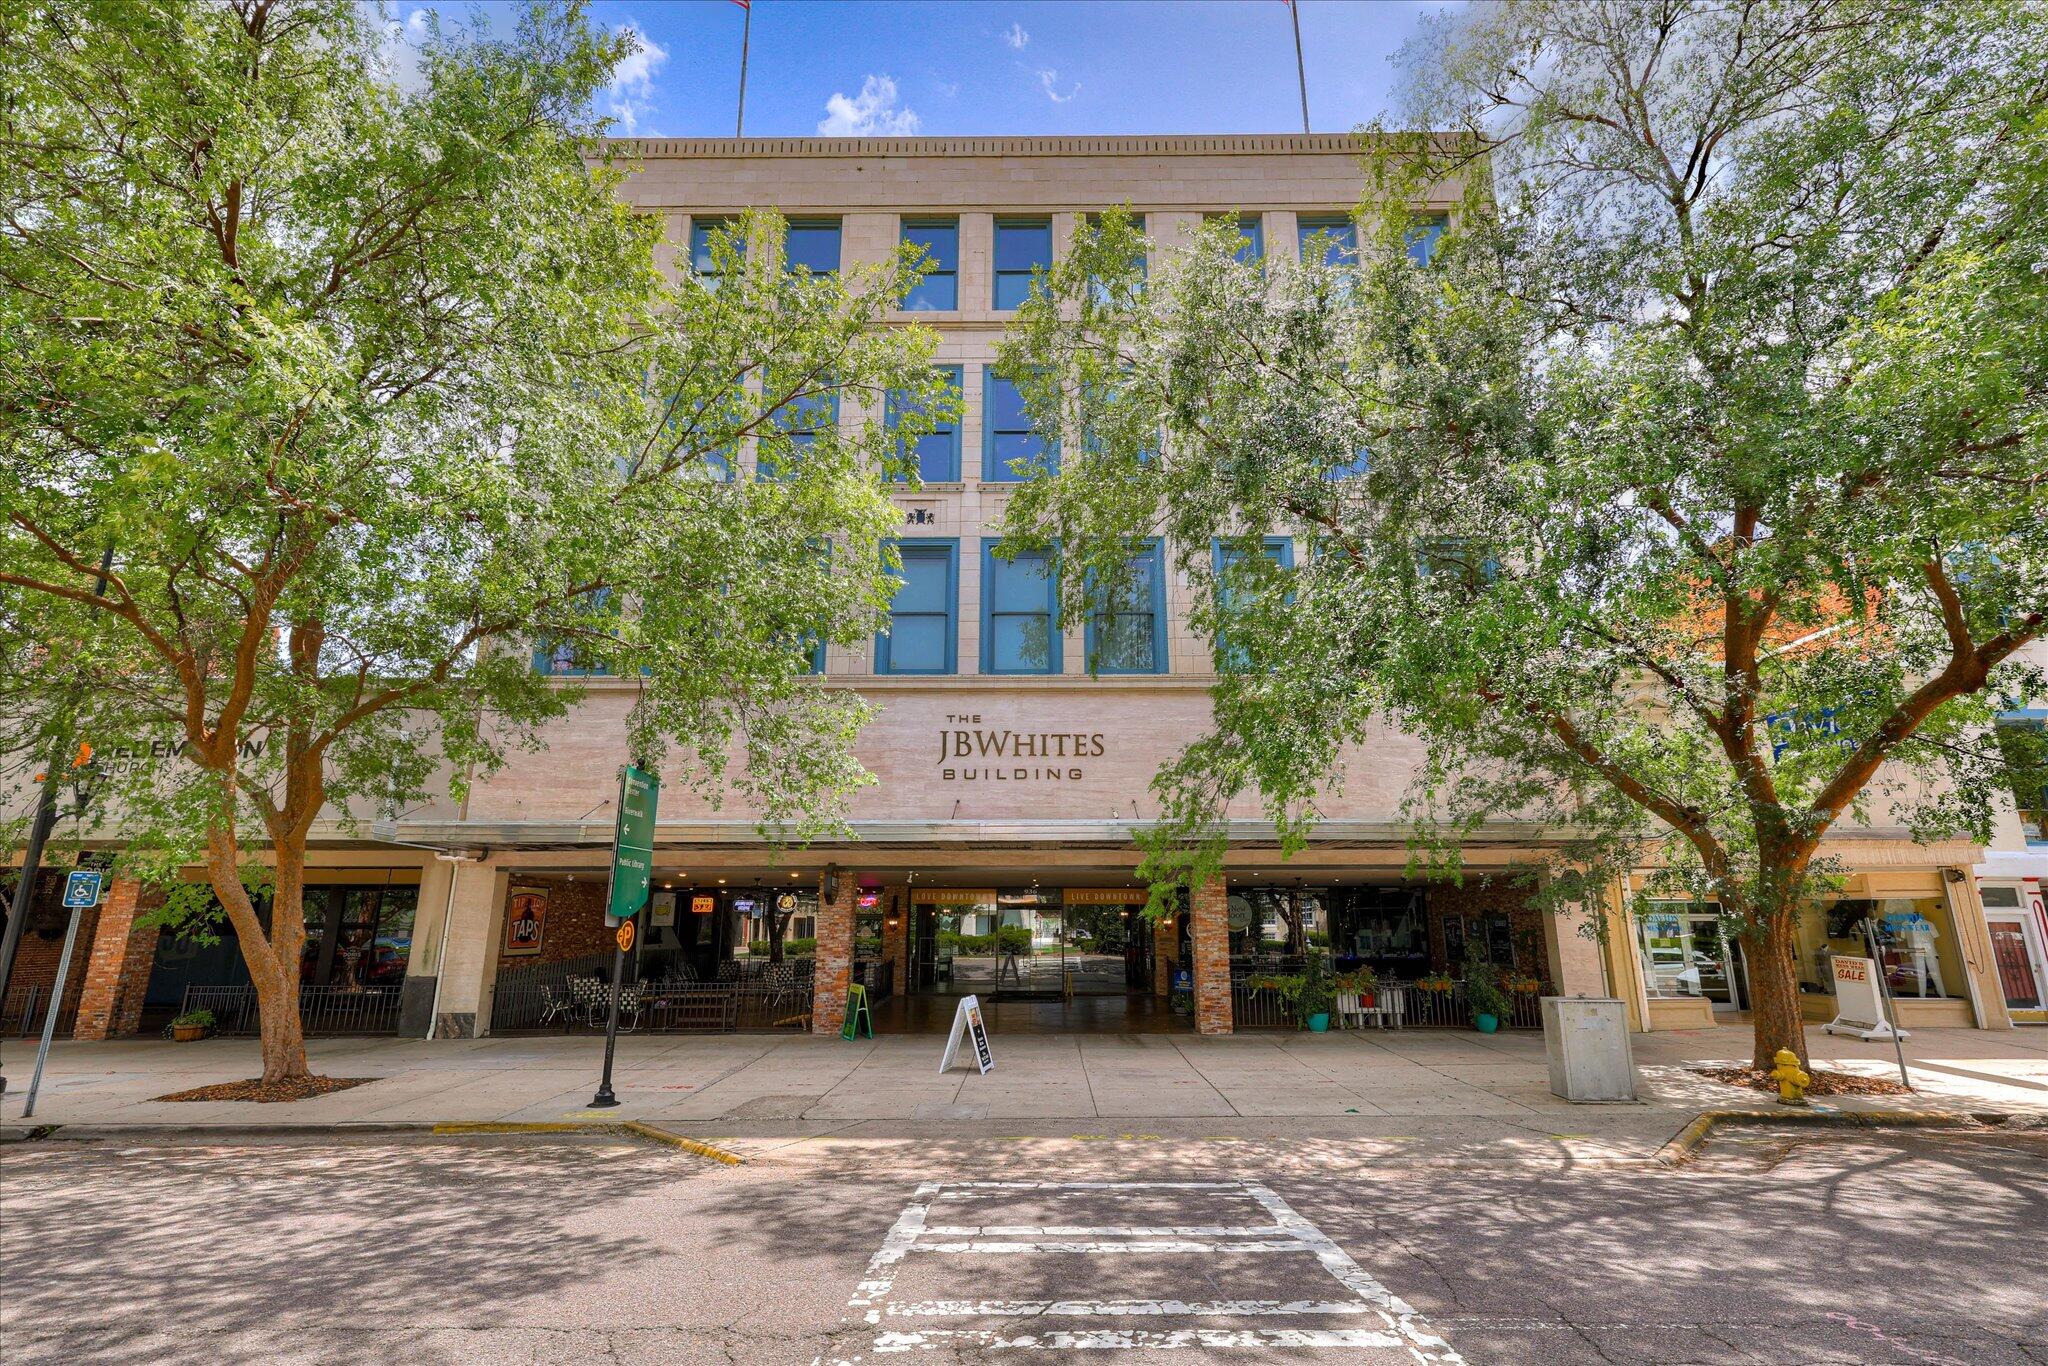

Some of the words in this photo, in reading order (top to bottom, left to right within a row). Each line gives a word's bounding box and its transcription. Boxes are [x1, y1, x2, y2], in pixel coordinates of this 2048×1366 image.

[946, 714, 982, 724] THE
[942, 768, 1083, 780] BUILDING
[619, 857, 632, 869] Public
[632, 859, 645, 871] Library
[916, 892, 937, 900] LOVE
[941, 892, 990, 901] DOWNTO
[1071, 892, 1089, 900] LIVE
[1094, 892, 1140, 900] DOWNTOWN
[512, 919, 540, 941] TAPS
[623, 926, 632, 946] P
[1838, 969, 1865, 981] SALE
